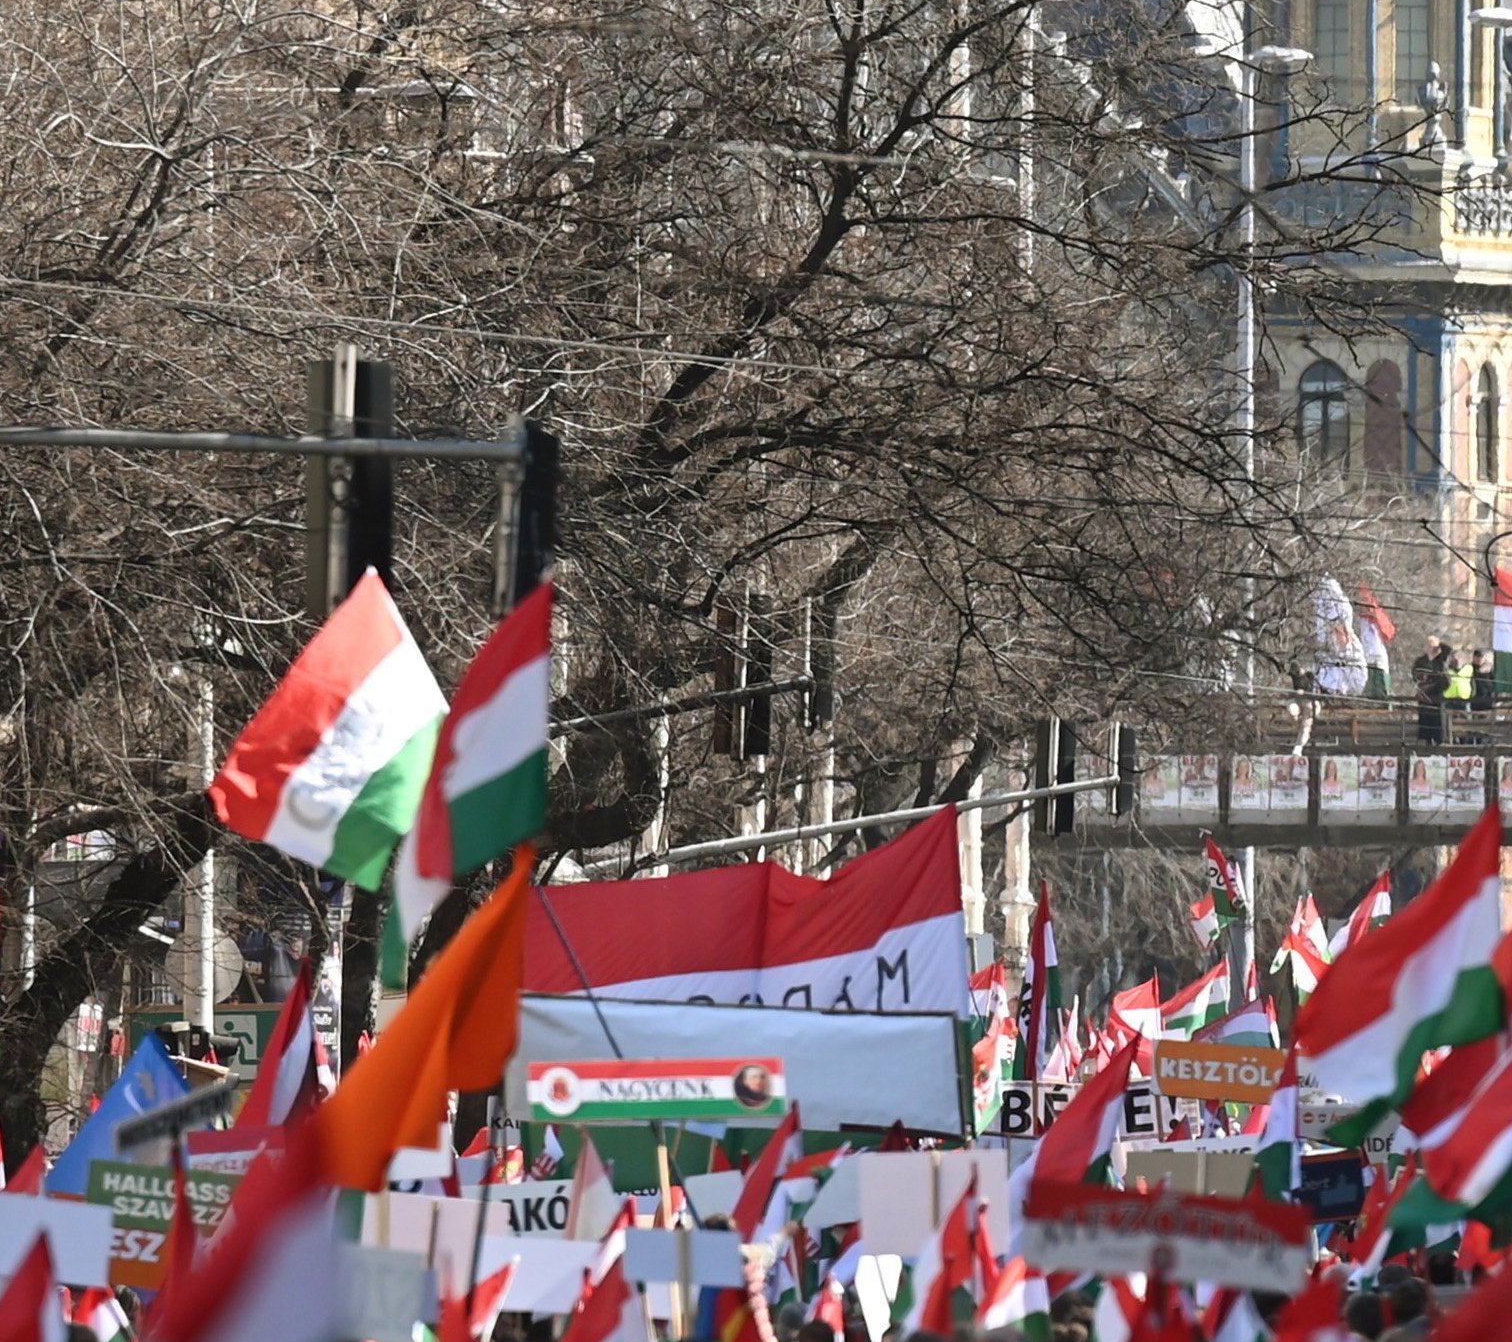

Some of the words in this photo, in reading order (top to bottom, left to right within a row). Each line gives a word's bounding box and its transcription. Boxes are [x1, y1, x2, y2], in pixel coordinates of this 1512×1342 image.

[600, 1079, 714, 1101] NAGYCENK
[1001, 1084, 1181, 1135] BÉE!
[112, 1196, 224, 1226] SZAVZZ
